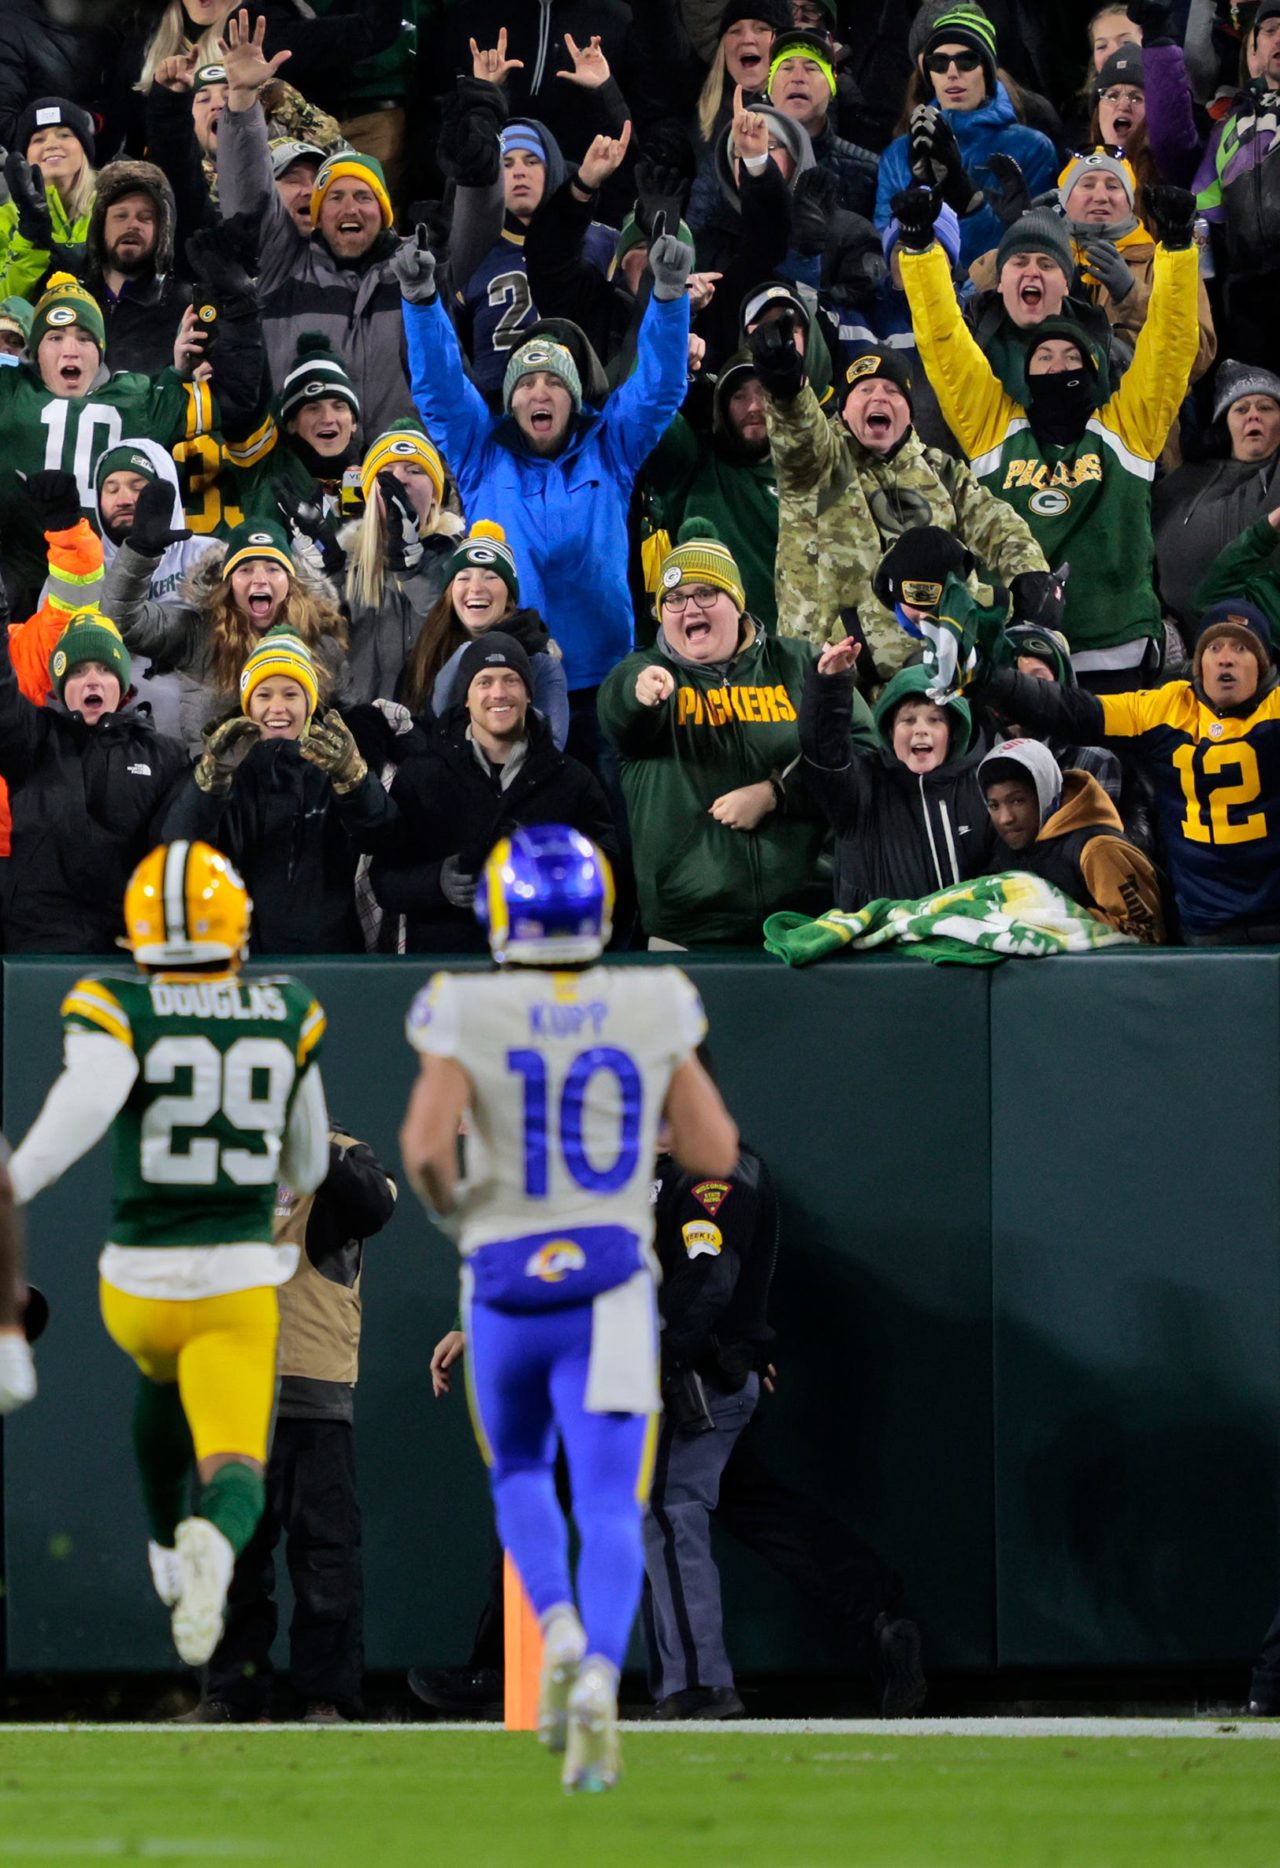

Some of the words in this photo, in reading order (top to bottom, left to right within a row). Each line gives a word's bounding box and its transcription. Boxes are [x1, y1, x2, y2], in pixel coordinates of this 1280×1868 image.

[47, 307, 76, 326] G
[487, 270, 534, 351] 2
[41, 399, 121, 507] 10
[1029, 488, 1070, 516] G
[467, 548, 497, 564] G
[678, 685, 797, 726] PACKERS
[1172, 741, 1267, 845] 12
[150, 984, 288, 1020] DOUGLAS
[527, 1001, 608, 1040] KUPP
[140, 1036, 296, 1185] 29
[507, 1046, 643, 1198] 10
